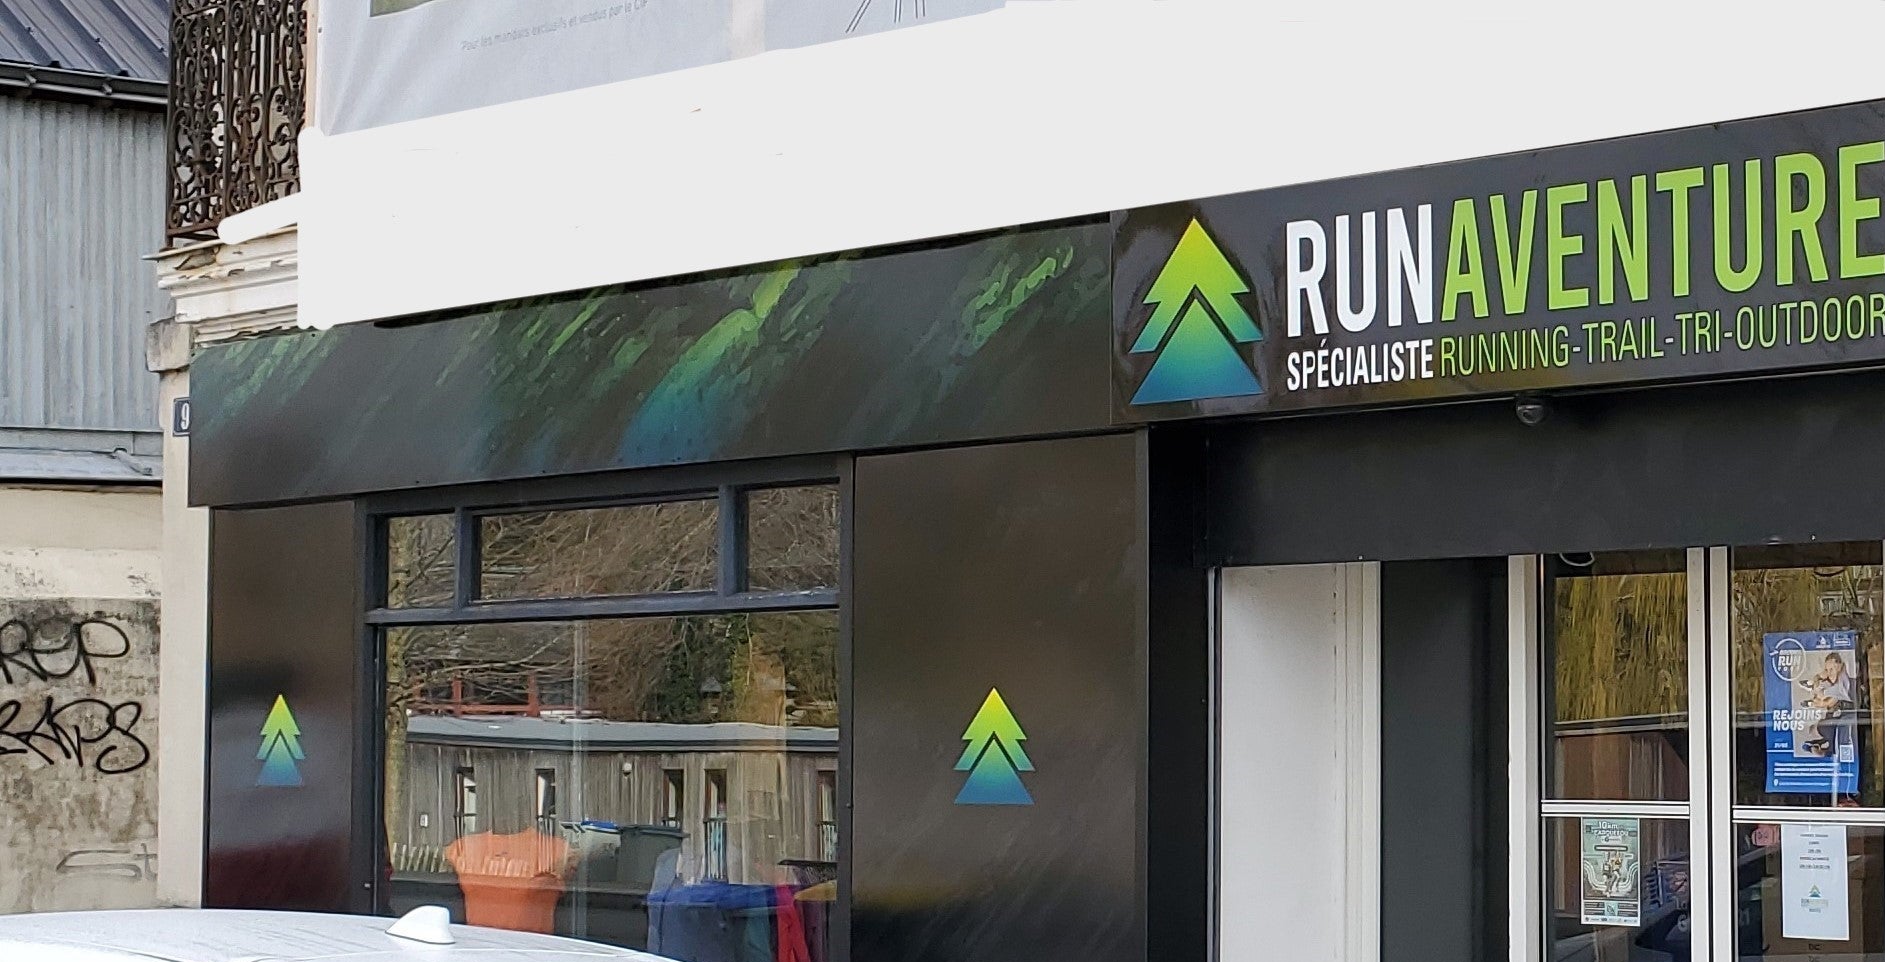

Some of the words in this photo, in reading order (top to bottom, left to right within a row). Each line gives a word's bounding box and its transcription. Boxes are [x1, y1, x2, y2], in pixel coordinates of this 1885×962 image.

[1286, 338, 1434, 391] SPÉCIALISTE
[1773, 709, 1822, 721] REJOINS
[1773, 720, 1805, 731] NOUS
